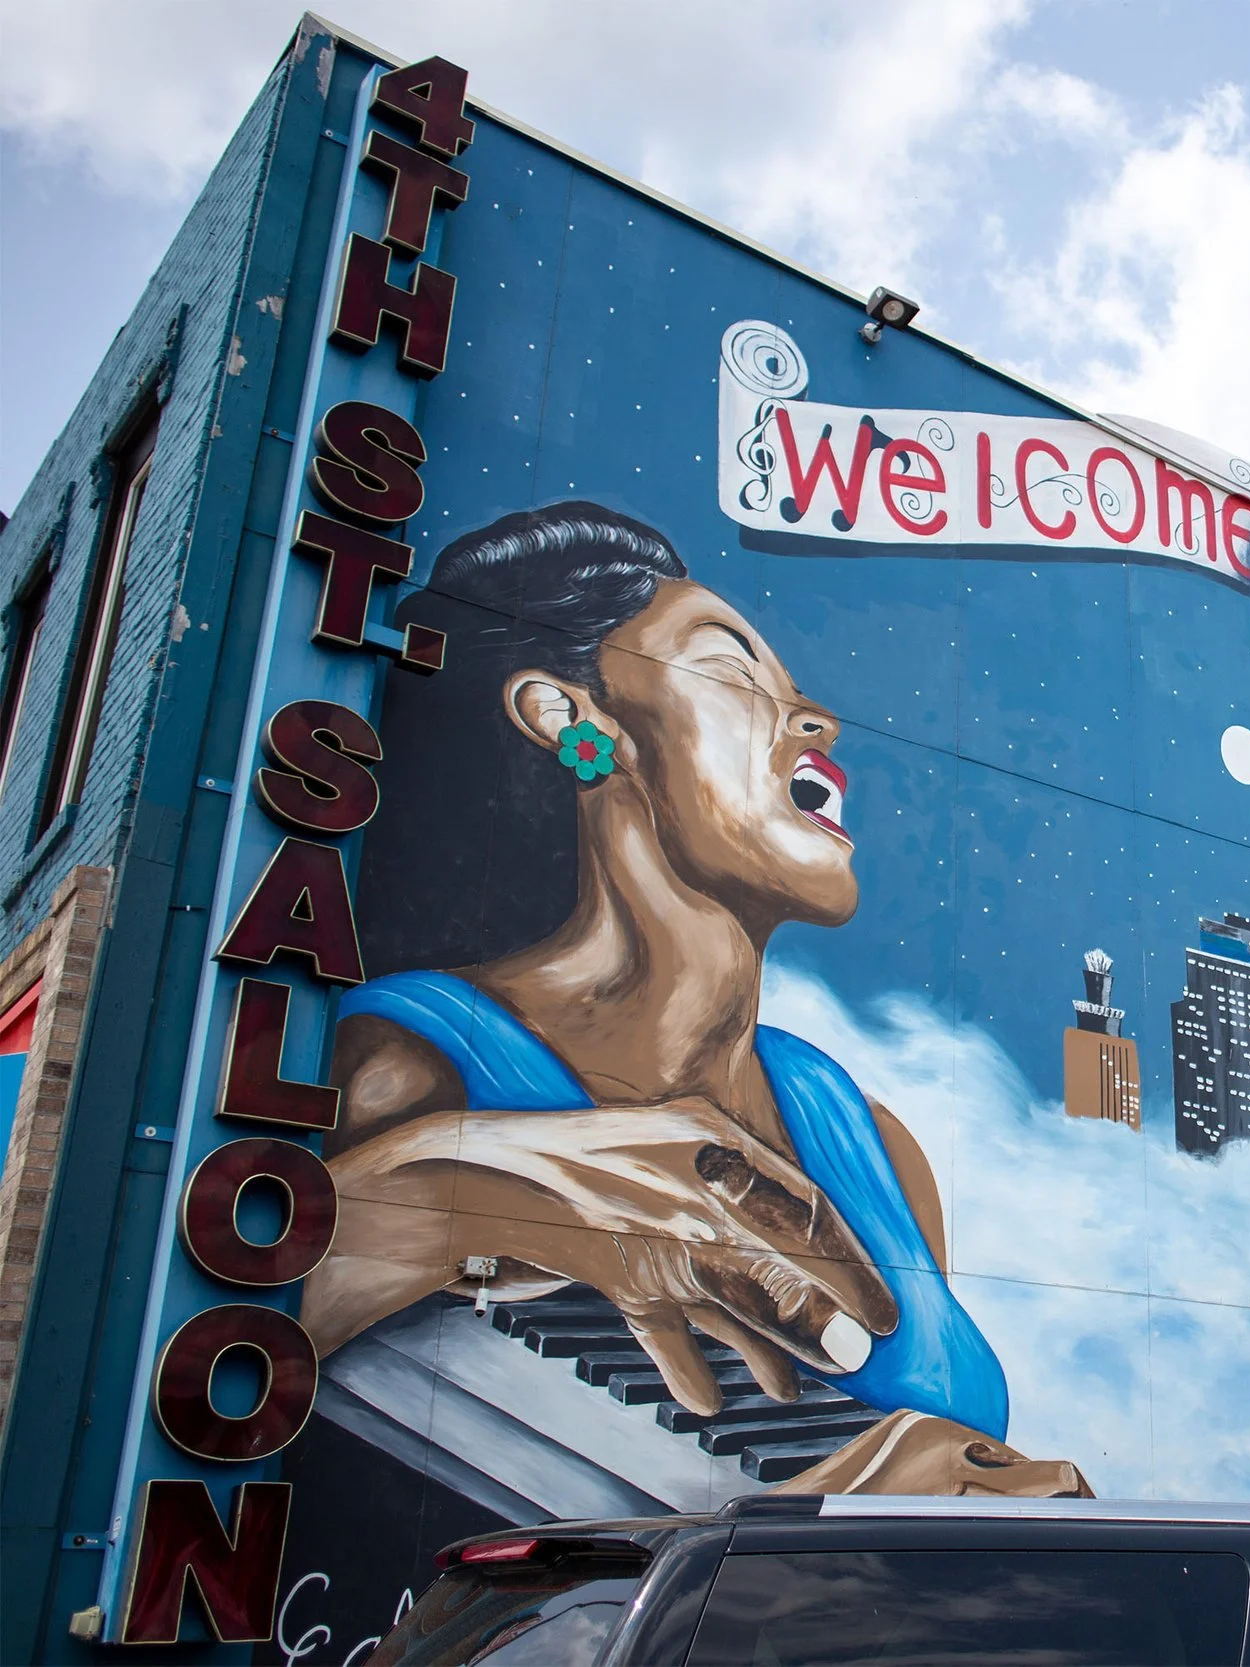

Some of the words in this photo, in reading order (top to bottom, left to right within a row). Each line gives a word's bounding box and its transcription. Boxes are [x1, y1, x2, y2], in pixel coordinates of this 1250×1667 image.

[328, 55, 476, 378] 4TH
[291, 400, 447, 672] ST.
[119, 699, 383, 1644] SALOON
